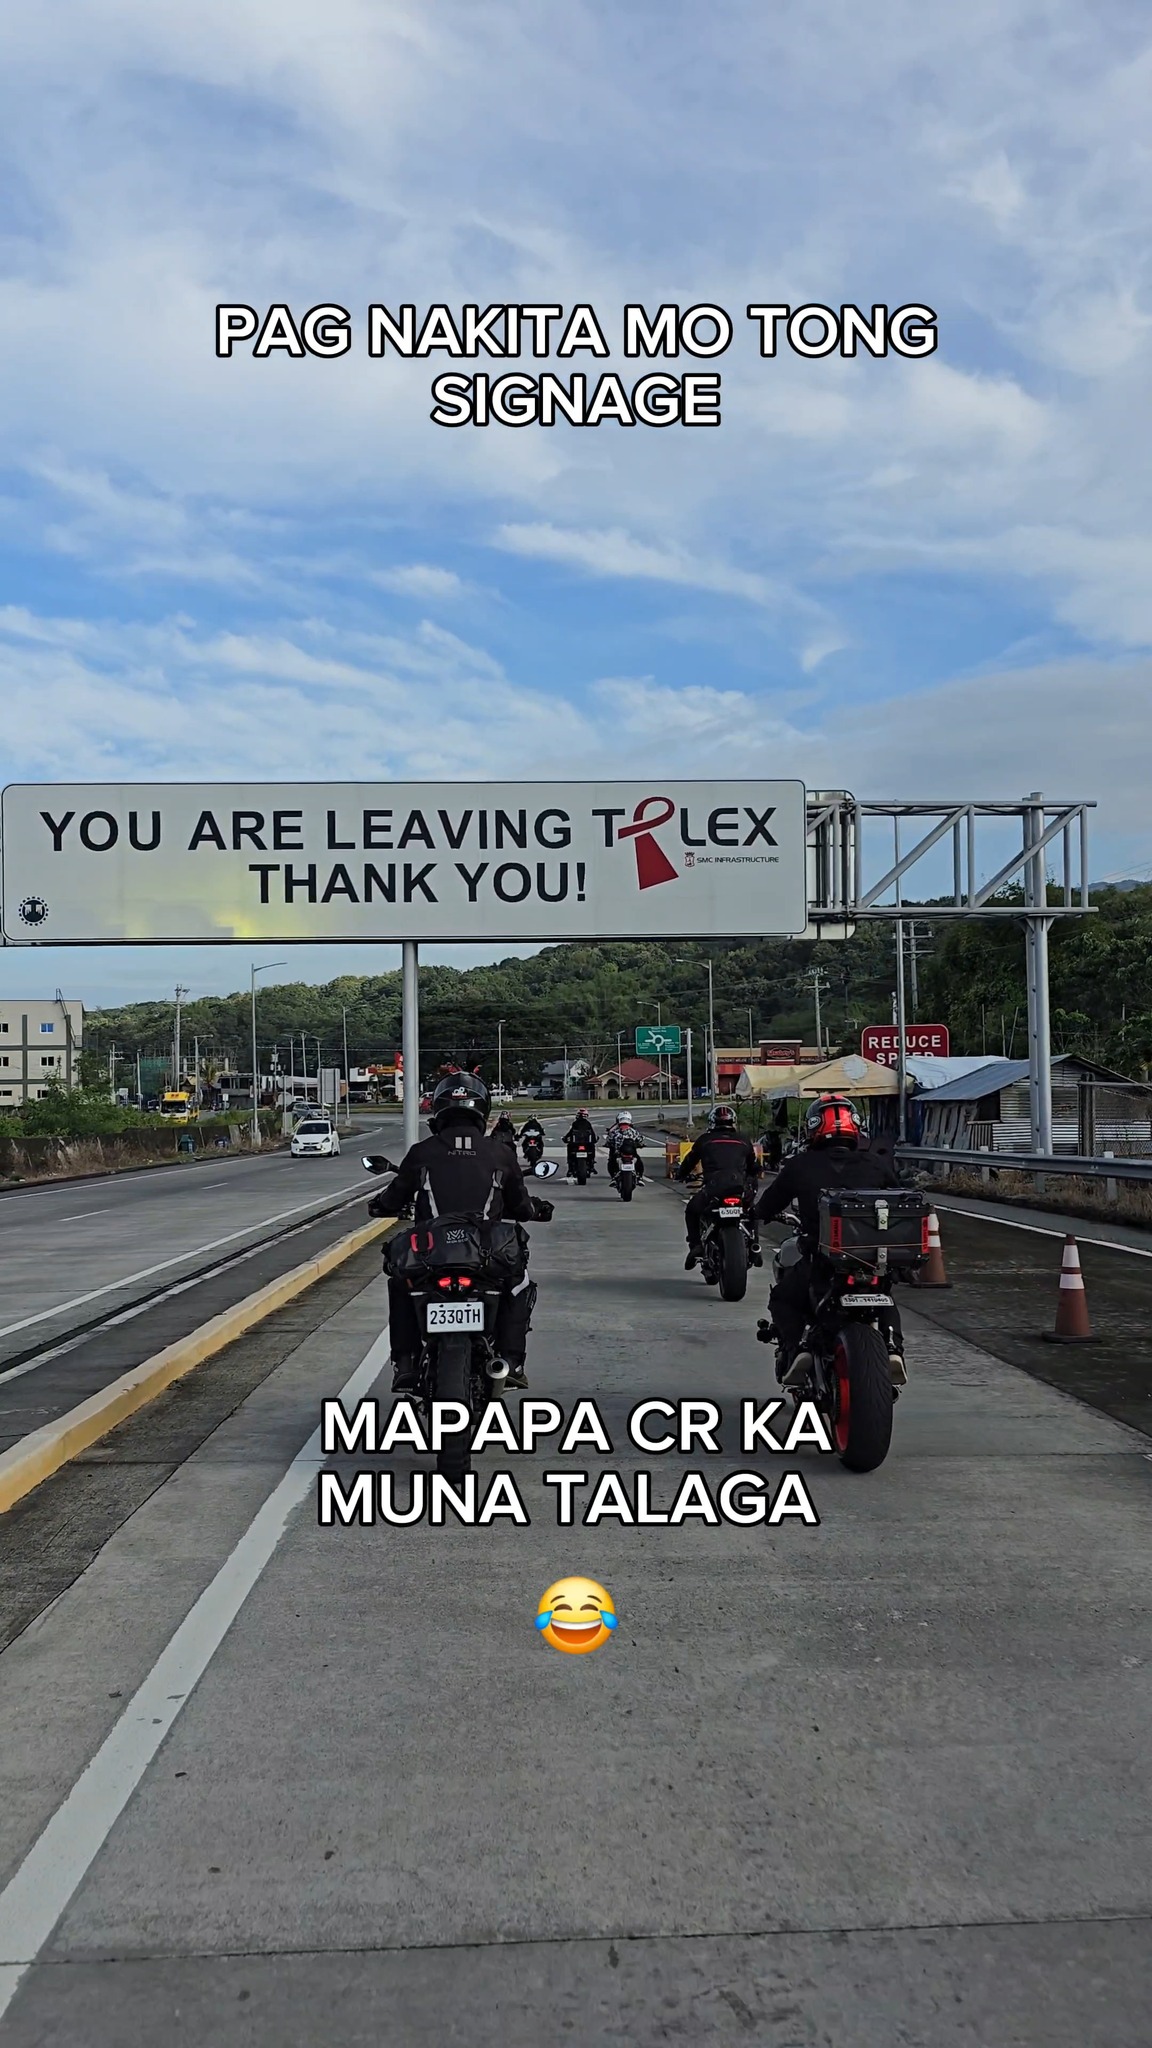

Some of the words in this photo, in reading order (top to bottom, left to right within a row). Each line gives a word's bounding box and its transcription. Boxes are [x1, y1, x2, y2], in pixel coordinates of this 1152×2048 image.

[39, 810, 161, 852] YOU
[188, 810, 304, 851] ARE
[327, 808, 572, 850] LEAVING
[697, 856, 713, 864] SMC
[249, 863, 439, 904] THANK
[455, 862, 586, 903] YOU!
[868, 1035, 941, 1049] REDUCE
[430, 1309, 480, 1325] 233QTH
